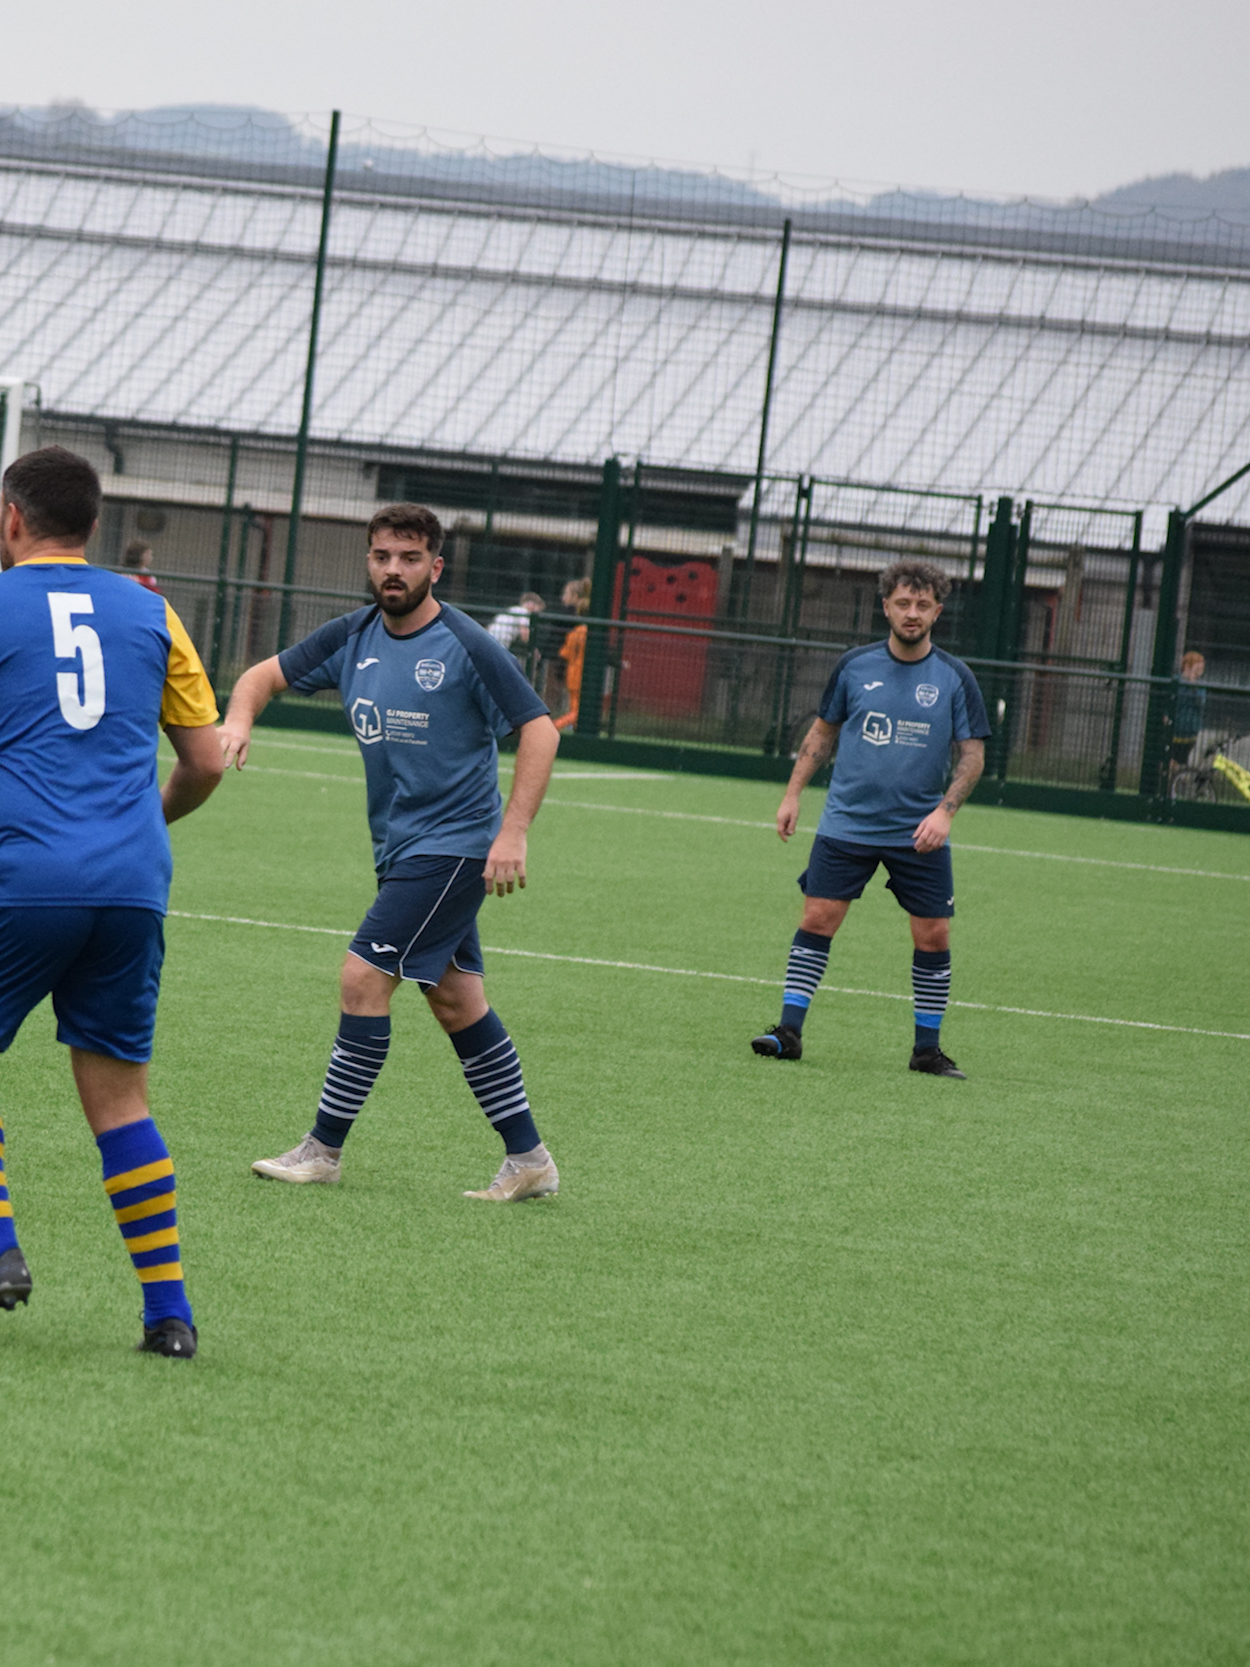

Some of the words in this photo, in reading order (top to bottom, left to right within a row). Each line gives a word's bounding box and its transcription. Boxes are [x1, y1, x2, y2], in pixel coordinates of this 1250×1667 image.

[46, 591, 106, 731] 5
[386, 709, 395, 717] GJ
[396, 710, 430, 721] PROPERTY
[386, 717, 429, 728] MAINTENANCE
